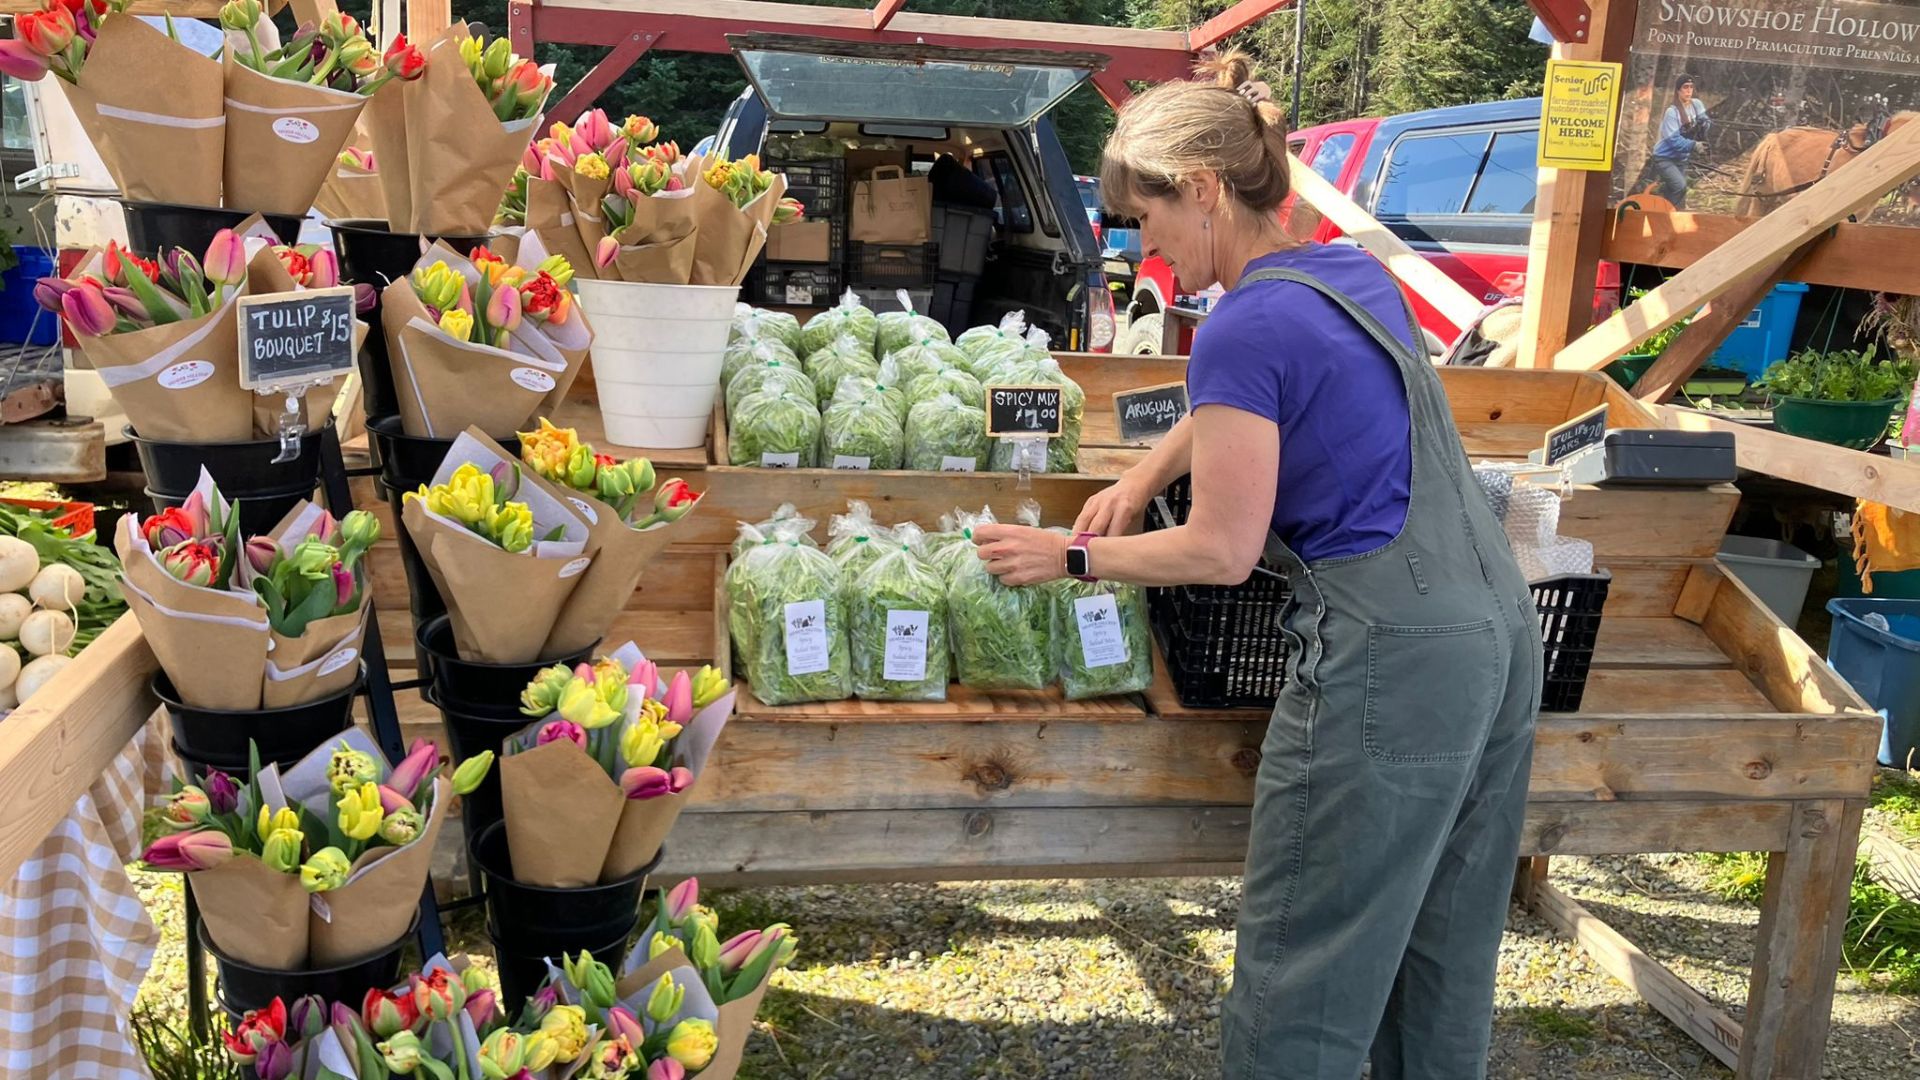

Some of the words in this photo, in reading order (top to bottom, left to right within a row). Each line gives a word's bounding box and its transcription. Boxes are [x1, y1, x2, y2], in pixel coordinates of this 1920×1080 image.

[1659, 0, 1806, 31] SNOWSHOE
[1809, 6, 1920, 42] HOLLOW
[1648, 28, 1683, 44] PONY
[1686, 31, 1743, 49] POWERED
[1746, 36, 1844, 57] PERMACULTURE
[1845, 44, 1911, 63] PERENNIALS
[1554, 74, 1584, 84] Senior
[1550, 116, 1605, 128] WELCOME
[1559, 128, 1595, 138] HERE!
[251, 305, 316, 330] TULIP
[321, 308, 350, 342] $15
[254, 332, 325, 360] BOUQUET
[995, 391, 1034, 407] SPICY
[1037, 392, 1058, 407] MIX
[1125, 399, 1175, 420] ARUGULA
[1551, 437, 1580, 458] JARS
